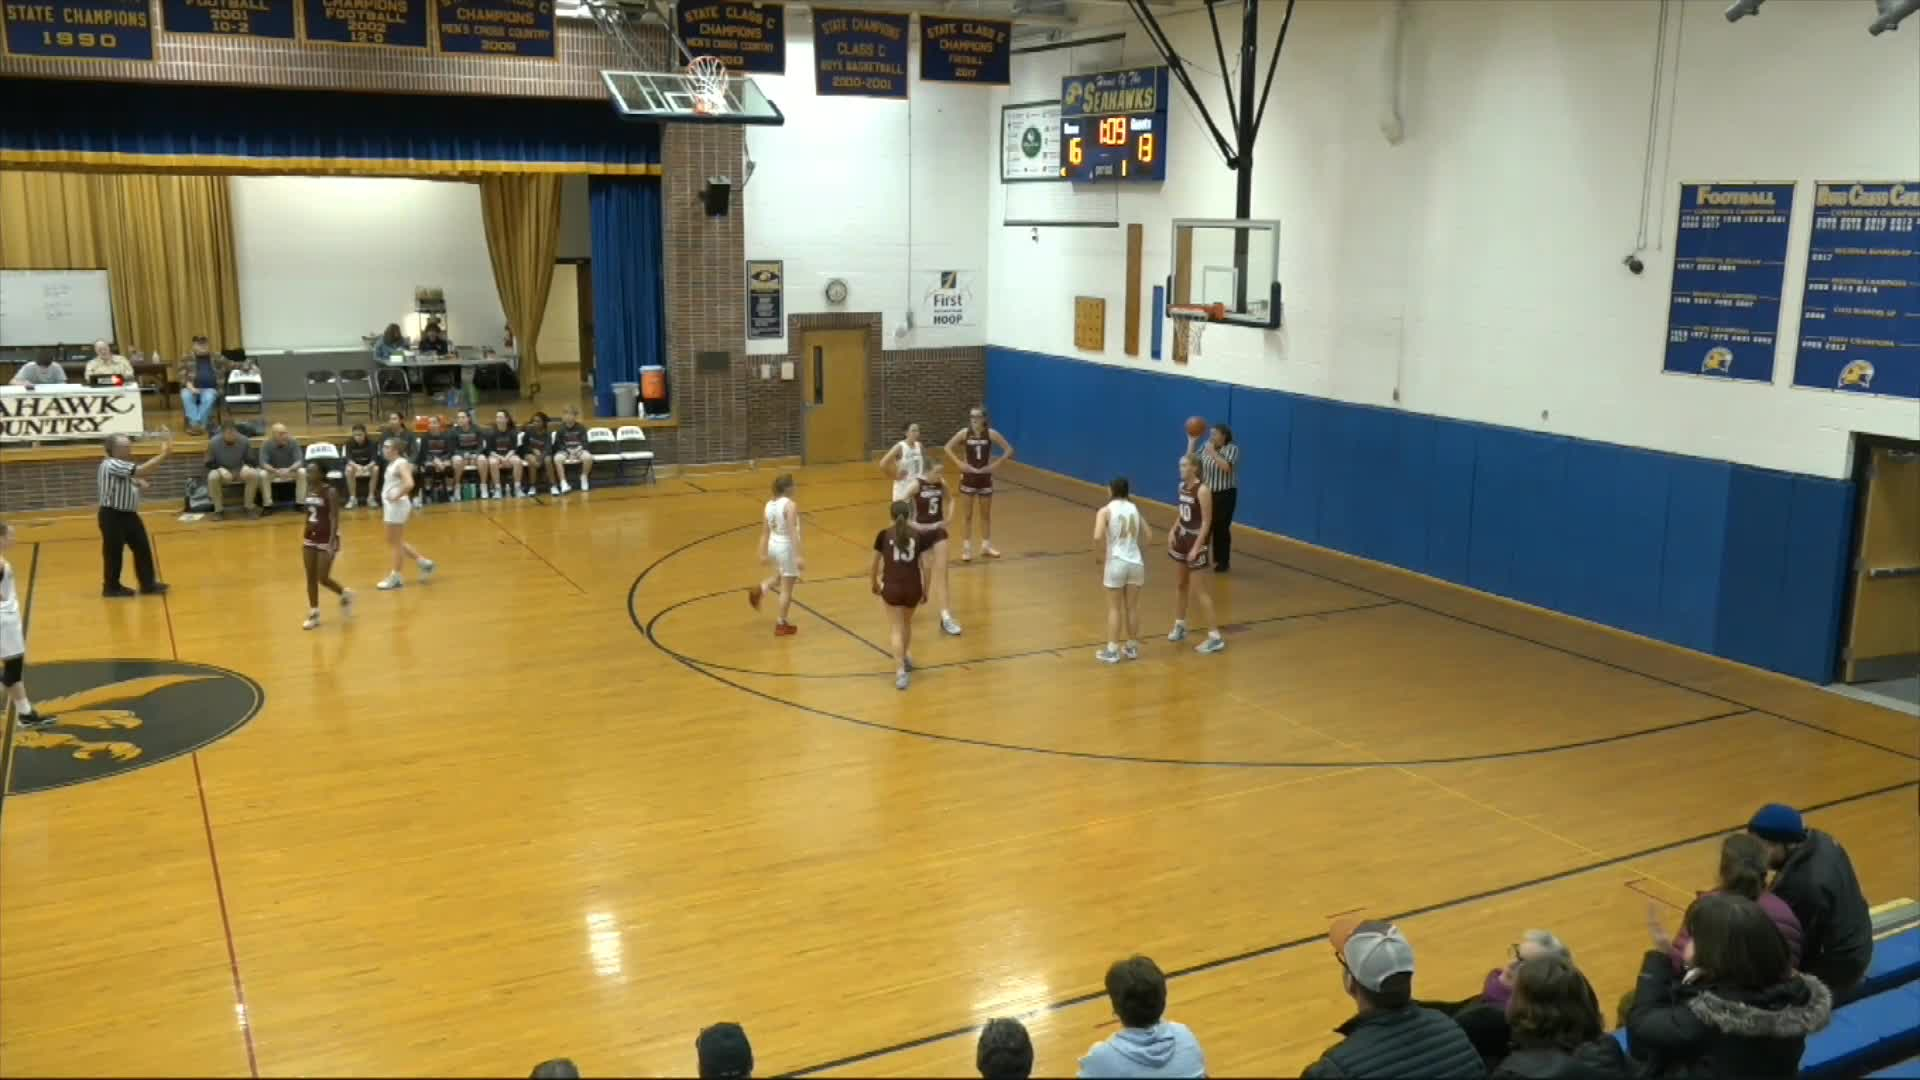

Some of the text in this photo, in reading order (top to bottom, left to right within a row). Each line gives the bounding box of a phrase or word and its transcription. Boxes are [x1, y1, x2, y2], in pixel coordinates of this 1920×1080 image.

[7, 5, 147, 28] STATE CHAMPIONS
[209, 9, 248, 20] 2001
[326, 7, 406, 24] FOOTBALL
[456, 8, 535, 24] CHAMPIONS
[685, 6, 718, 23] STATE
[725, 5, 763, 25] CLASS
[212, 20, 248, 33] 10-2
[699, 23, 762, 39] CHAMPIONS
[821, 16, 901, 40] STATE CHAMPIONS
[927, 23, 957, 39] STATE
[962, 23, 993, 39] CLASS
[43, 32, 117, 48] 1990
[939, 39, 993, 53] CHAMPIONS
[837, 42, 875, 57] CLASS
[846, 60, 904, 75] BASKETBALL
[1082, 82, 1154, 112] SEAHAWKS
[1099, 117, 1127, 145] 1:09
[1069, 137, 1083, 165] 6
[1138, 133, 1153, 162] 13
[1696, 185, 1776, 206] FOOTBALL
[933, 293, 963, 307] First
[933, 314, 963, 326] HOOP
[975, 445, 982, 461] 1
[308, 505, 321, 522] 2
